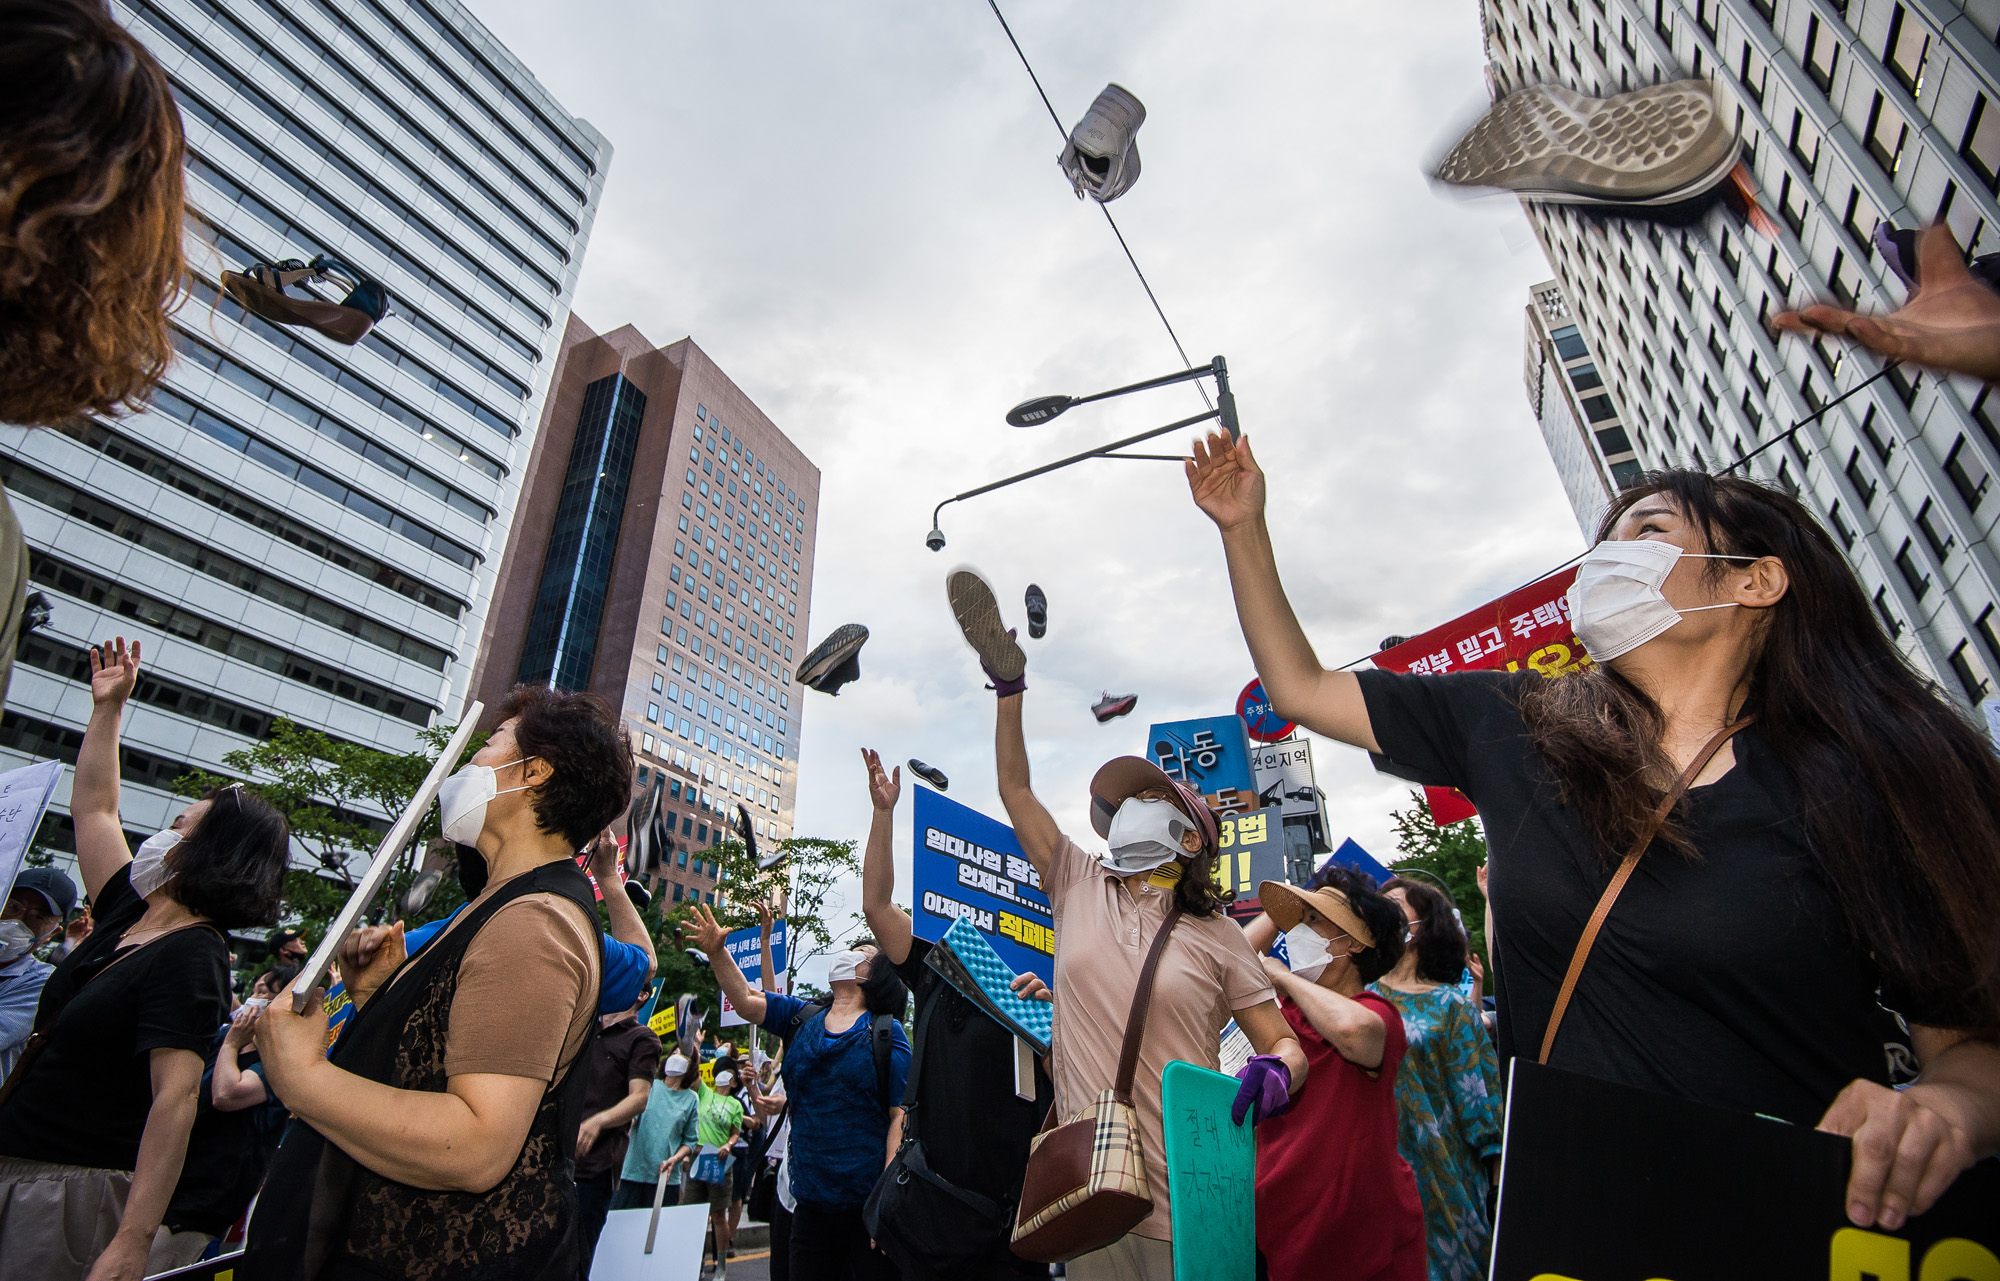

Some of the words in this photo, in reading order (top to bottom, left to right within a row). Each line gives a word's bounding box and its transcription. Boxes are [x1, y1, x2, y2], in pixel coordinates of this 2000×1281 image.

[1456, 625, 1506, 664] 믿고
[1158, 729, 1223, 782] 다동
[926, 827, 1001, 873] 임대사업
[923, 891, 993, 931] 이제와서
